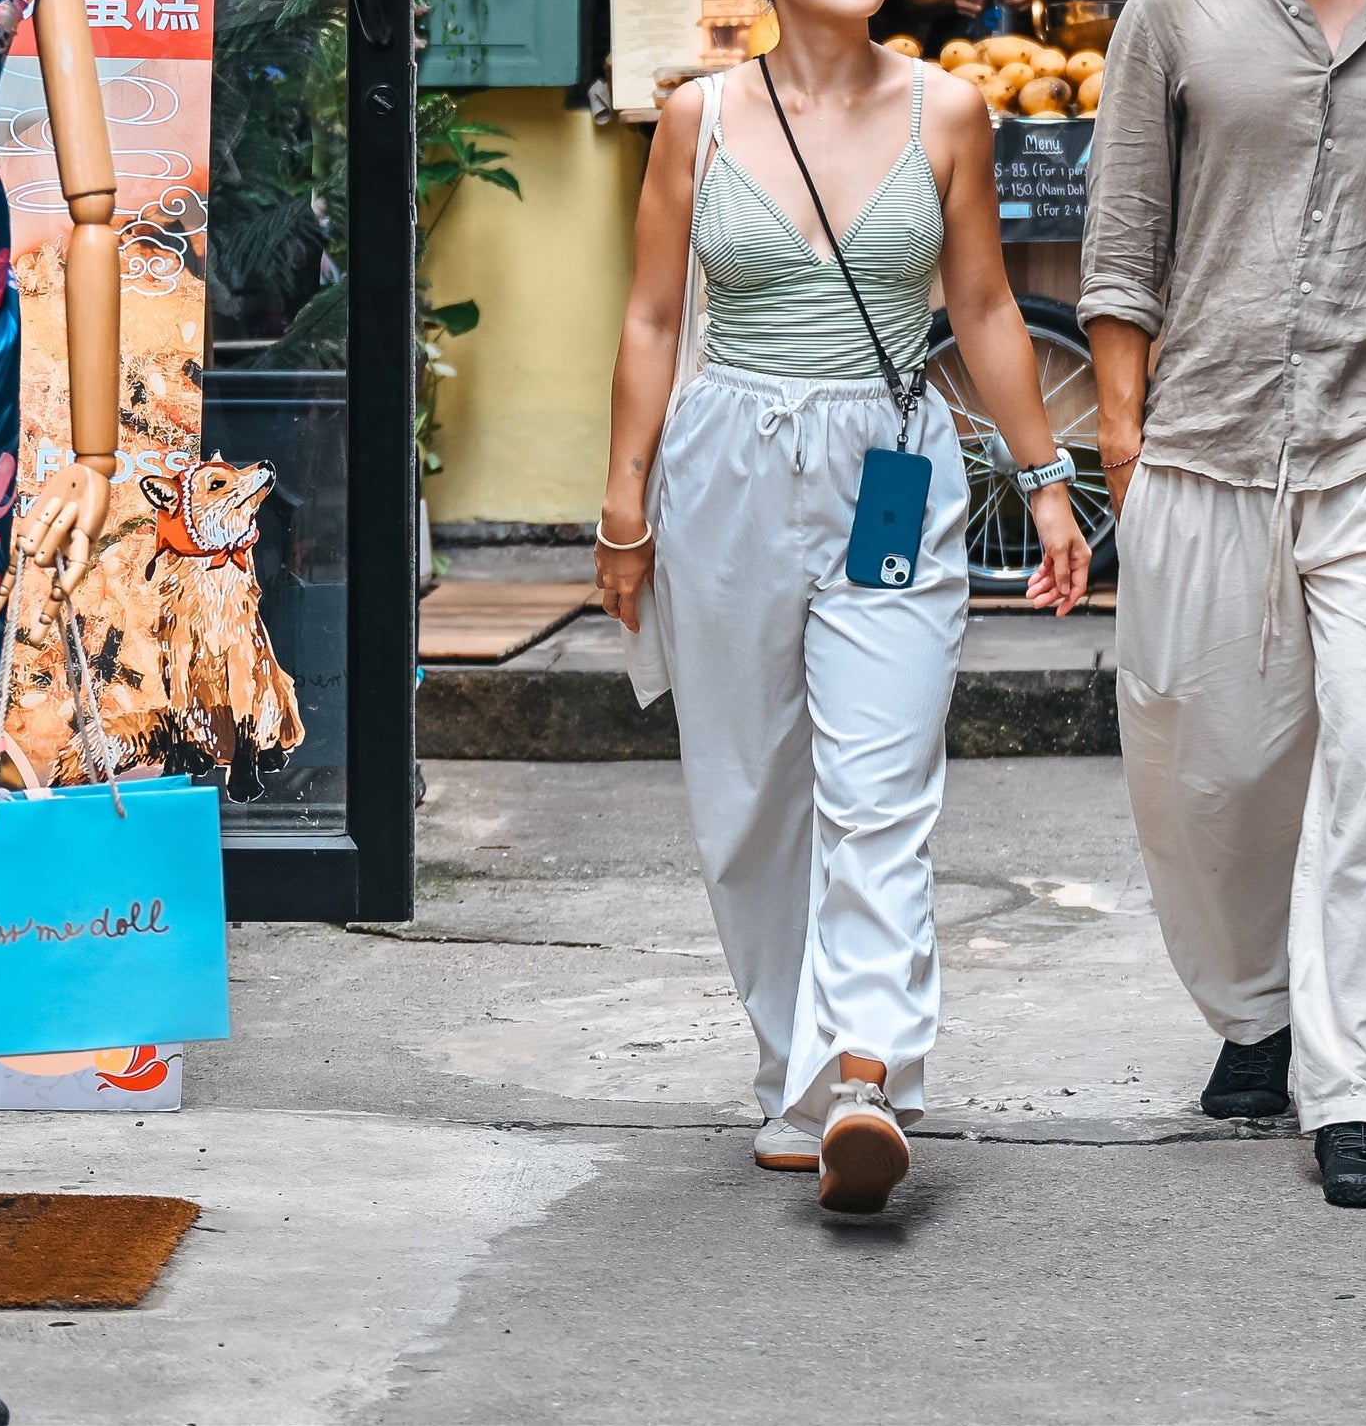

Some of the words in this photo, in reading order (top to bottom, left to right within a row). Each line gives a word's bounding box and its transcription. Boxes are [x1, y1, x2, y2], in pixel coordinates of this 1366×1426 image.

[1025, 134, 1060, 151] Menu
[1033, 162, 1056, 177] (For
[1036, 182, 1066, 198] (Nam
[1036, 202, 1060, 217] (For
[35, 920, 86, 942] me
[89, 898, 171, 938] doll
